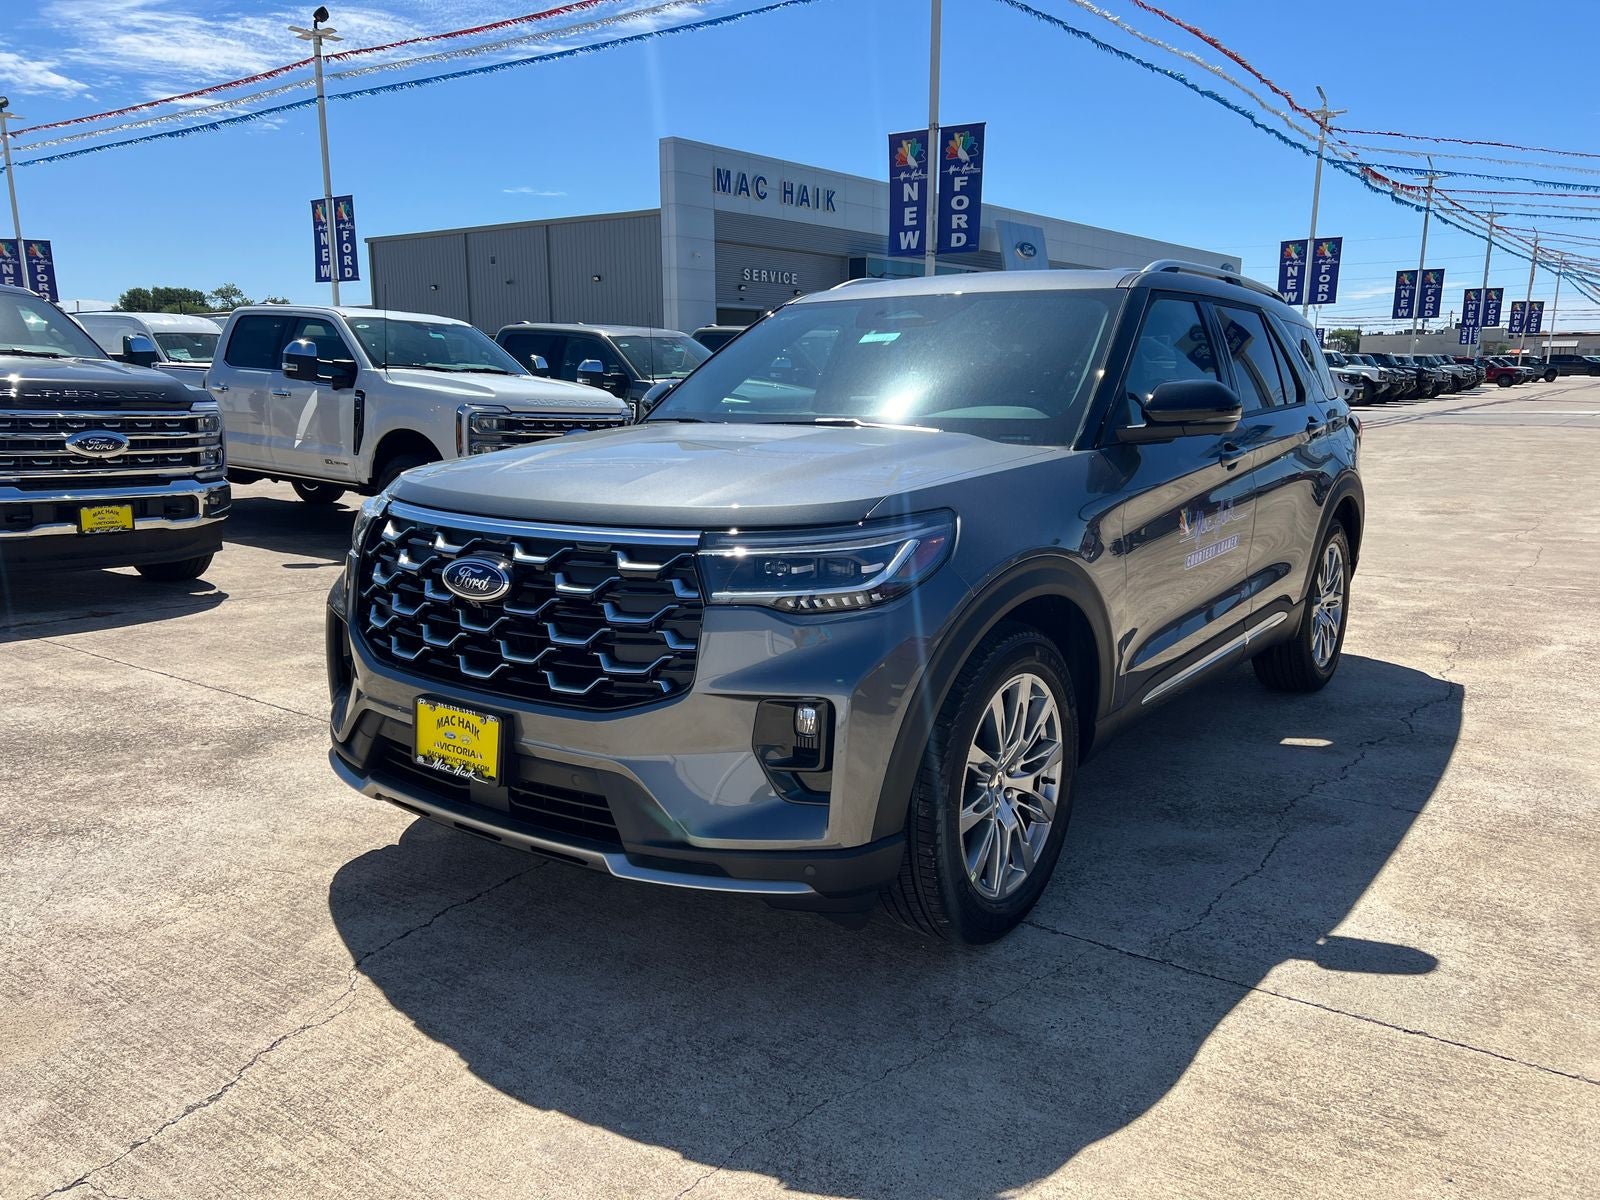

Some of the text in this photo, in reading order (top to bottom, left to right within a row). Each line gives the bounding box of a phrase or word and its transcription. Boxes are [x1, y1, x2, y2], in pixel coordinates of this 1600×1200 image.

[713, 166, 836, 212] MAC HAIK
[899, 182, 920, 250] NEW
[951, 176, 970, 248] FORD
[320, 232, 331, 278] NEW
[342, 231, 353, 278] FORD
[1, 264, 15, 286] NE
[743, 268, 798, 285] SERVICE
[1283, 266, 1298, 303] NEW
[1317, 264, 1331, 302] FORD
[1397, 290, 1410, 317] NEW
[1424, 288, 1436, 317] FORD
[1465, 304, 1476, 326] NEW
[1487, 303, 1497, 326] FORD
[1511, 313, 1521, 332] NEW
[1529, 313, 1538, 332] FORD
[85, 438, 115, 450] Ford
[454, 566, 491, 591] Ford
[436, 715, 456, 730] MAC
[457, 716, 480, 740] HAIK
[440, 741, 477, 758] VICTORIA
[431, 758, 478, 779] Mac Haik
